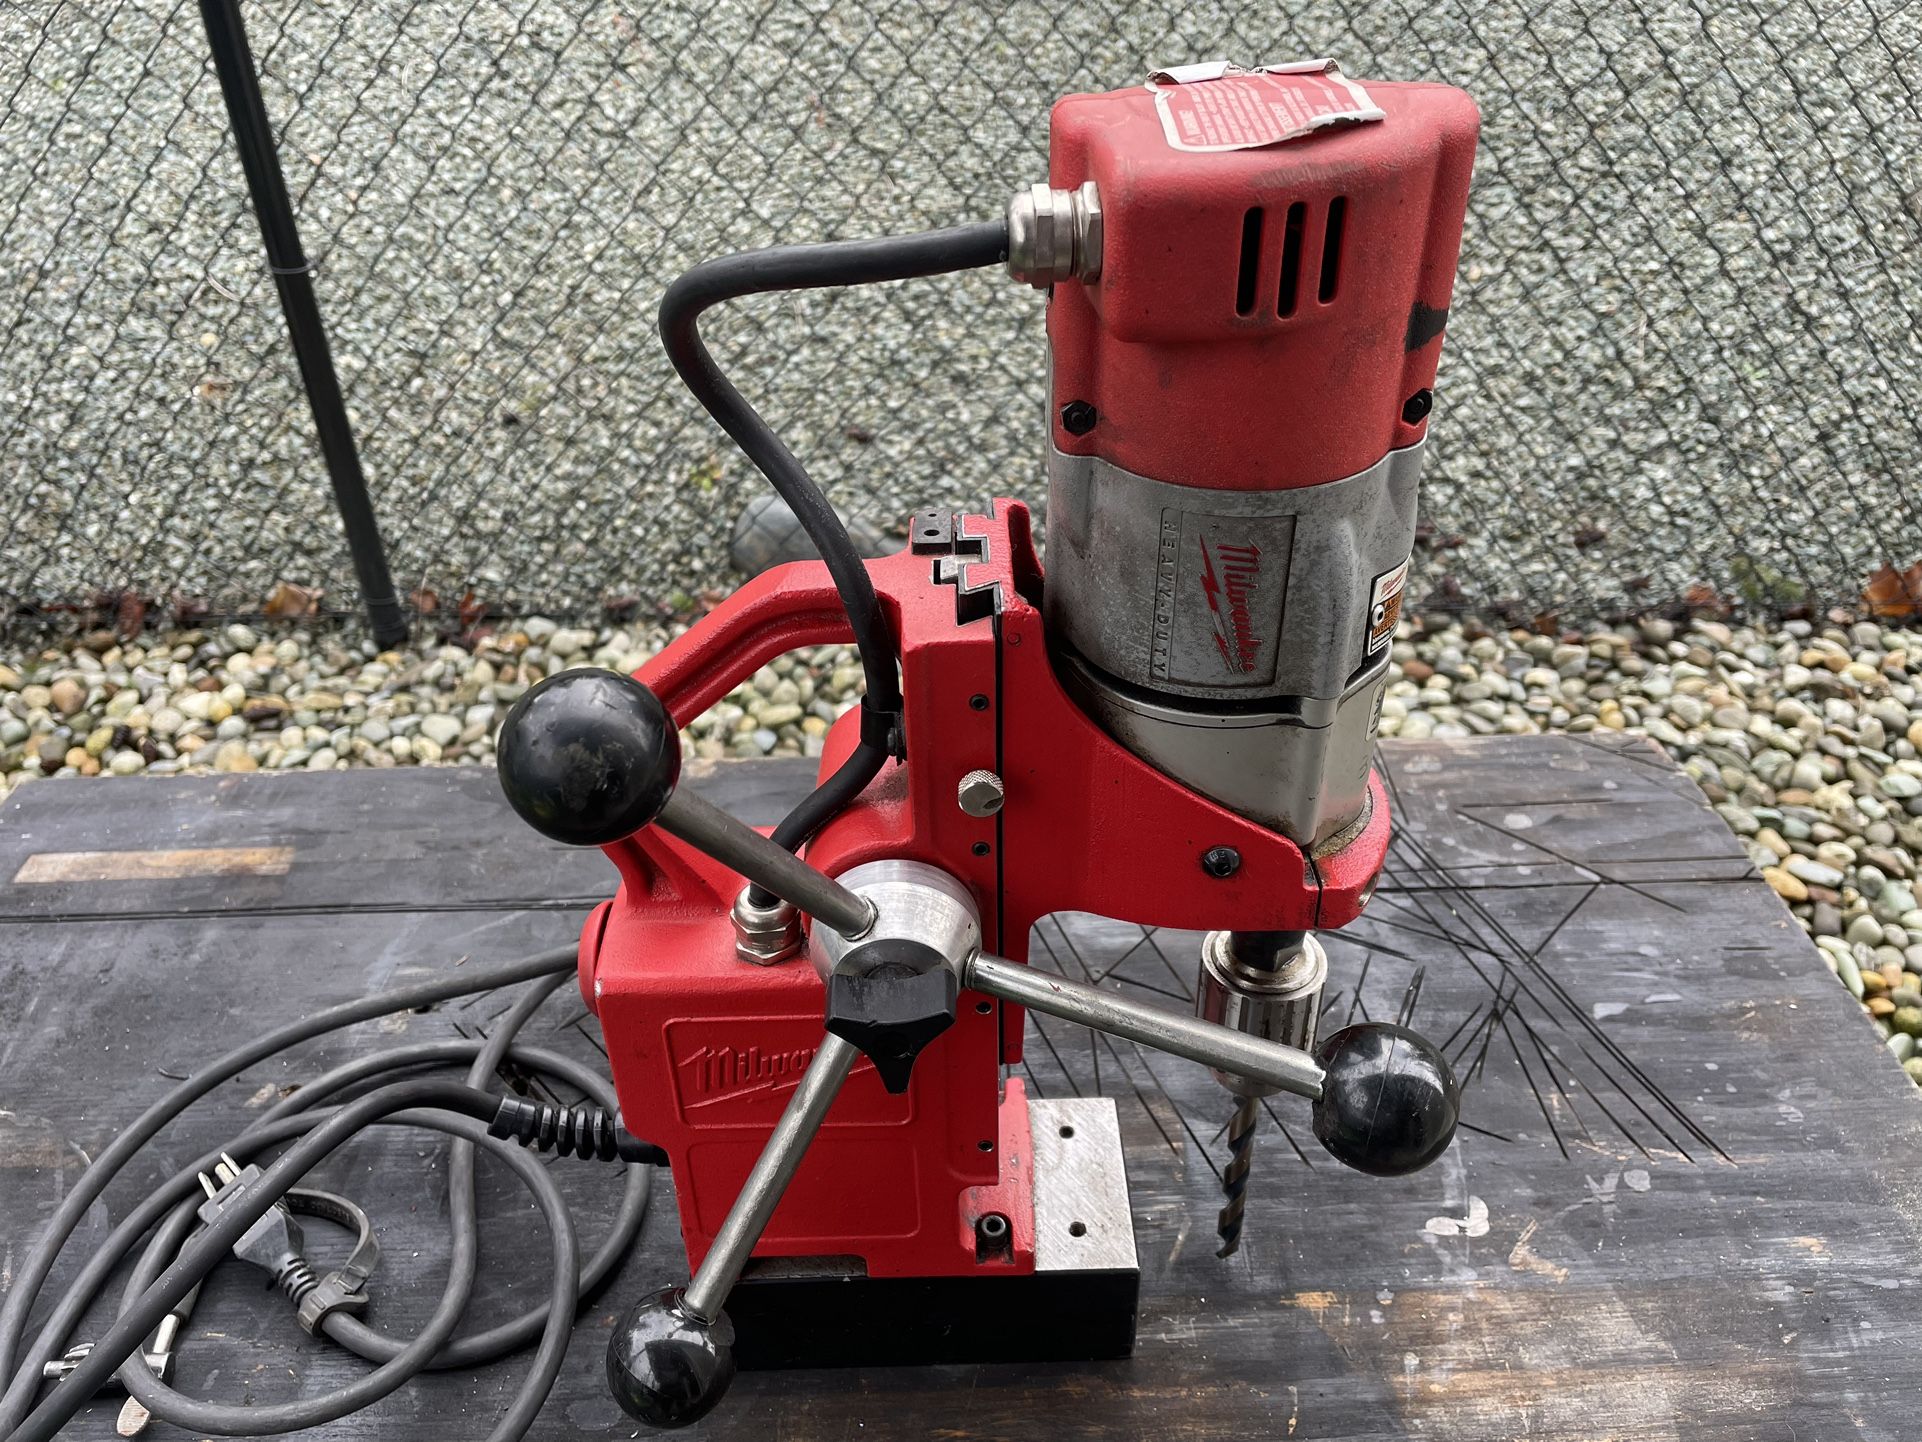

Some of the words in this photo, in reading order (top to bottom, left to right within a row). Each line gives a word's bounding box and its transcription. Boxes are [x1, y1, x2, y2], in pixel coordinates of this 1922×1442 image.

[1154, 520, 1177, 673] HEAVY-DUTY
[1216, 539, 1263, 673] Milwaukee
[678, 1046, 820, 1093] Milwa
